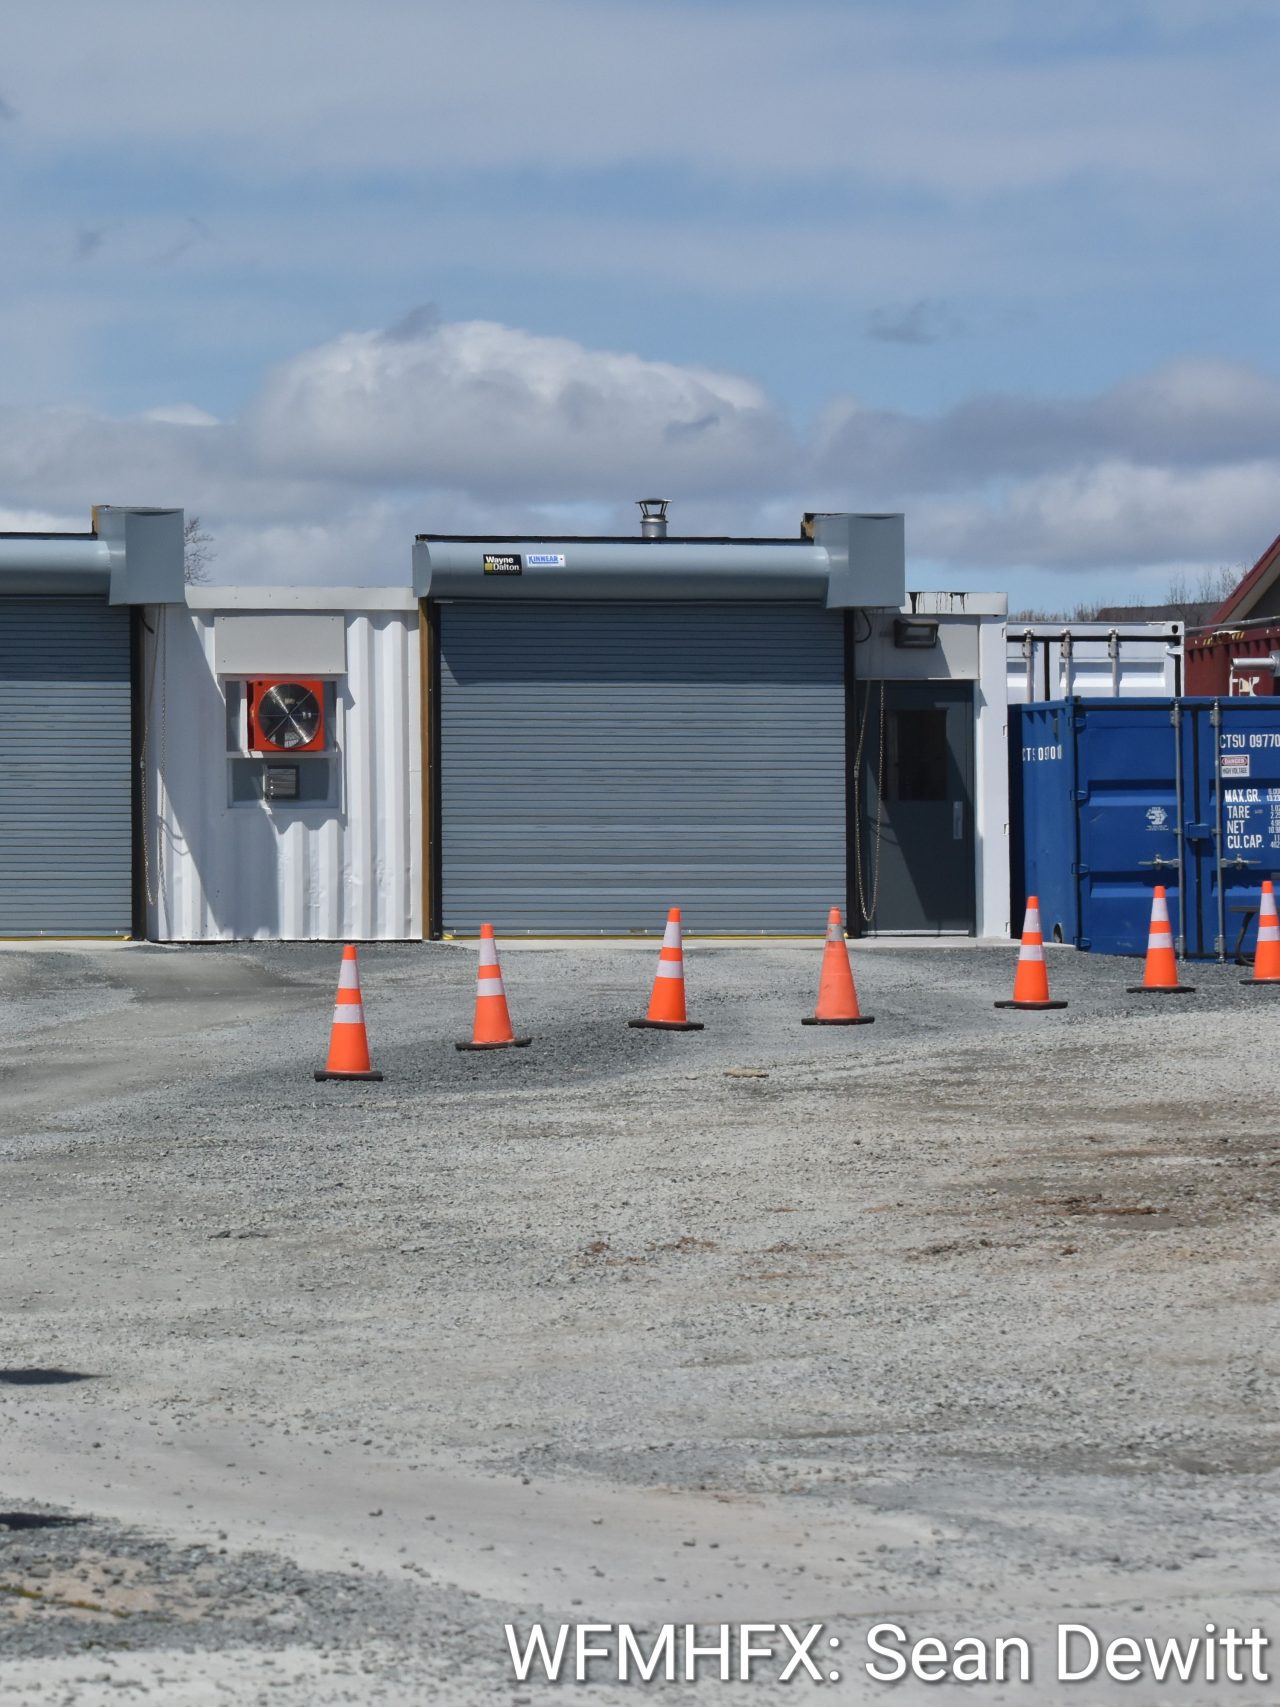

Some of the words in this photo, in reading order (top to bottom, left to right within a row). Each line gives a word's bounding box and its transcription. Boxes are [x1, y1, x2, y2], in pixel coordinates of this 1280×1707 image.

[485, 556, 514, 564] Wayne
[493, 563, 520, 571] Dalton
[1220, 734, 1245, 749] CTSU
[1224, 789, 1261, 803] MAX.GR.
[1227, 805, 1250, 819] TARE
[1227, 820, 1245, 834] NET
[1228, 834, 1264, 849] CU.CAP.
